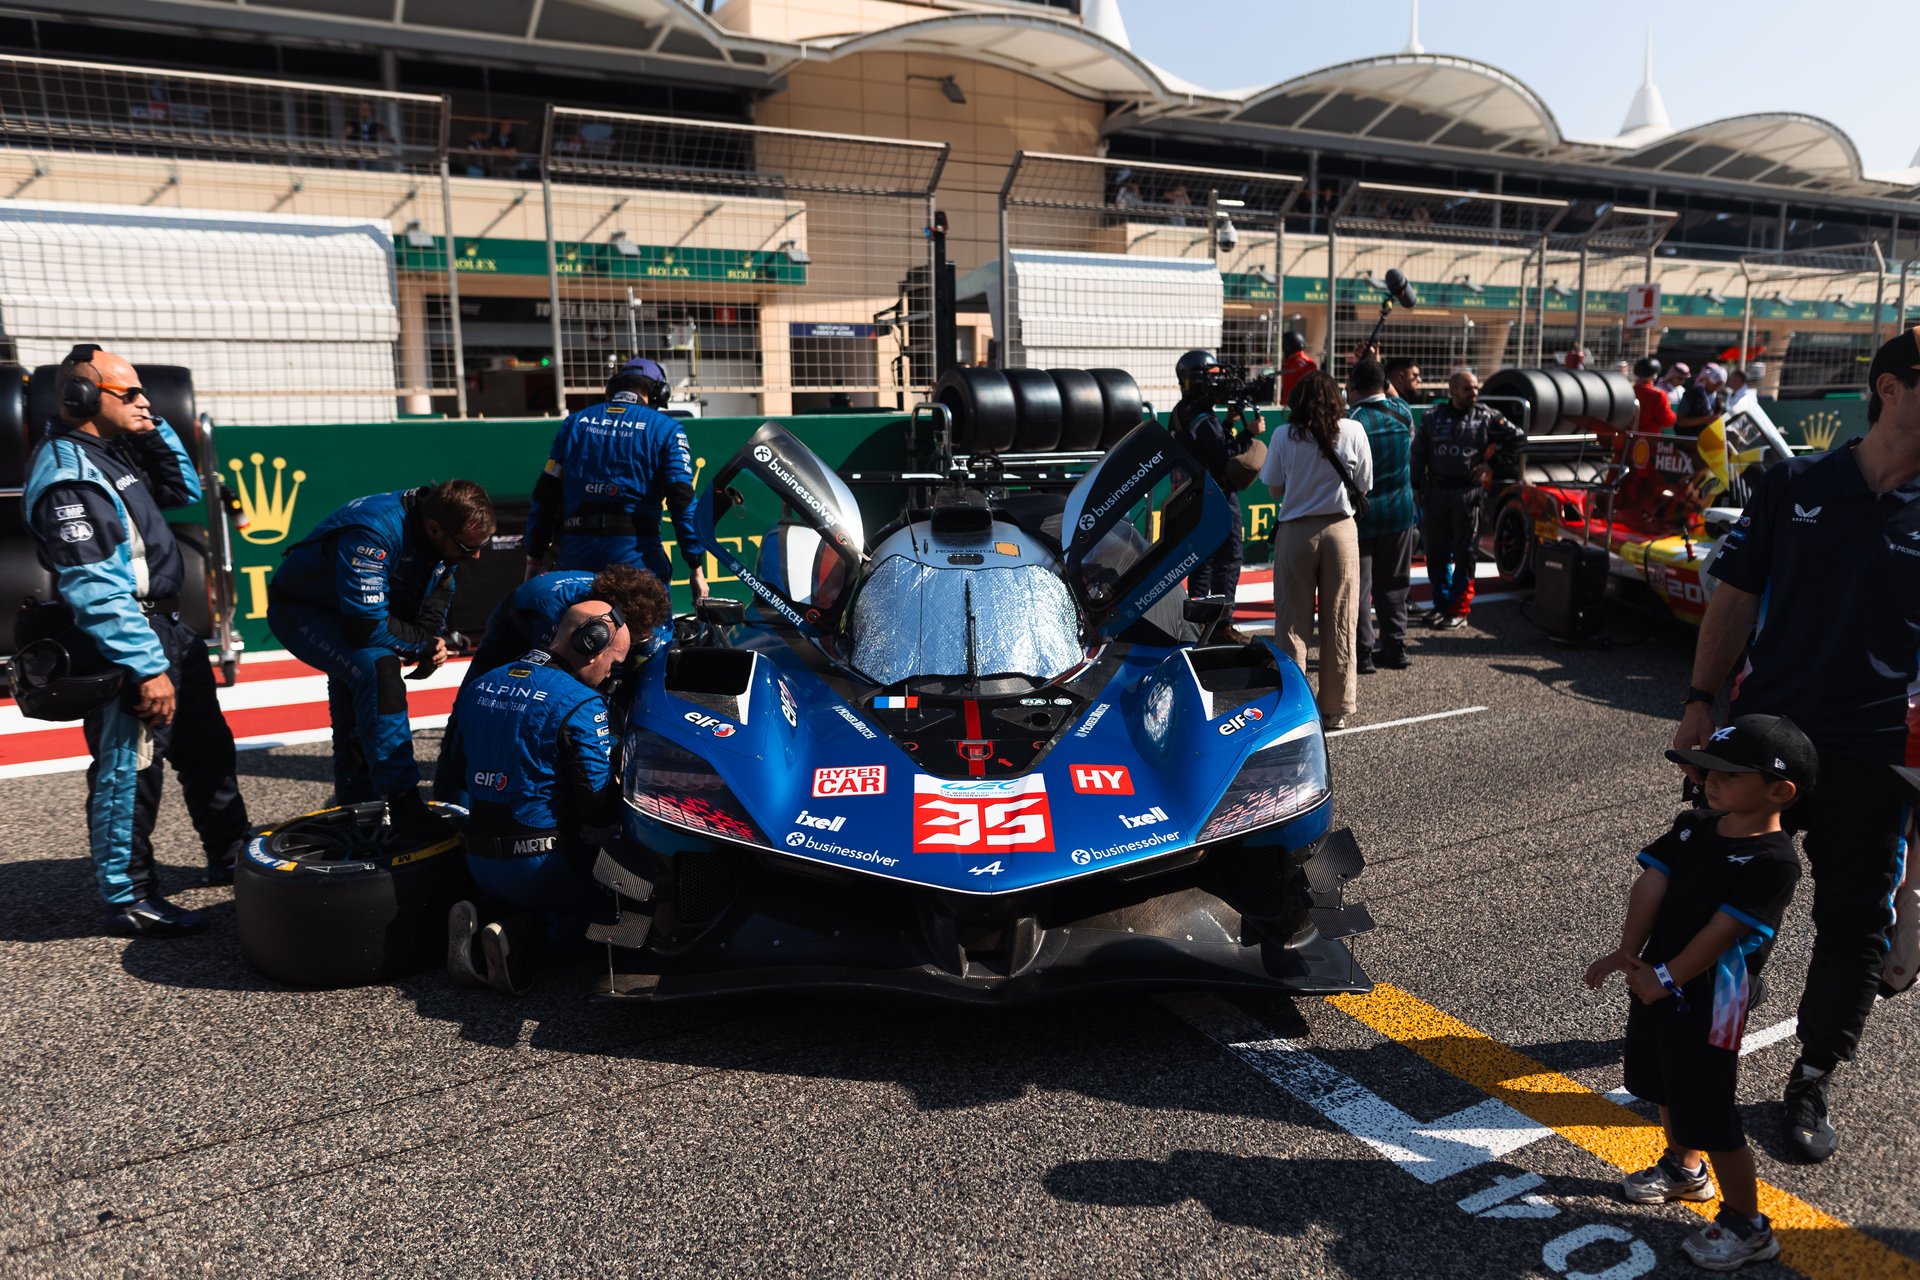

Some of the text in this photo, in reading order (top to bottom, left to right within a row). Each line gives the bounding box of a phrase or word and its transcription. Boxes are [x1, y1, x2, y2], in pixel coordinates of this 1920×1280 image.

[579, 416, 647, 430] ALPINE
[1657, 442, 1675, 454] Shell
[1655, 453, 1695, 475] HELIX
[585, 483, 606, 494] elf
[768, 458, 841, 527] businessolver
[1093, 450, 1165, 518] businessolver
[56, 506, 85, 518] OMP
[356, 545, 376, 556] elf
[1135, 552, 1200, 611] MOSER.WATCH
[738, 568, 804, 627] MOSER.WATCH
[299, 626, 363, 678] ALPINE
[476, 682, 548, 701] ALPINE
[510, 701, 527, 712] TEAM
[684, 711, 718, 729] elf
[1218, 716, 1247, 736] elf
[474, 771, 497, 787] elf
[818, 767, 881, 780] HYPER
[1075, 769, 1125, 789] HY
[817, 777, 880, 794] CAR
[795, 810, 847, 832] ixell
[917, 797, 1047, 846] 35
[1118, 806, 1170, 829] ixell
[513, 836, 558, 854] MRTC
[804, 835, 899, 868] businessolver
[1090, 830, 1180, 861] businessolver
